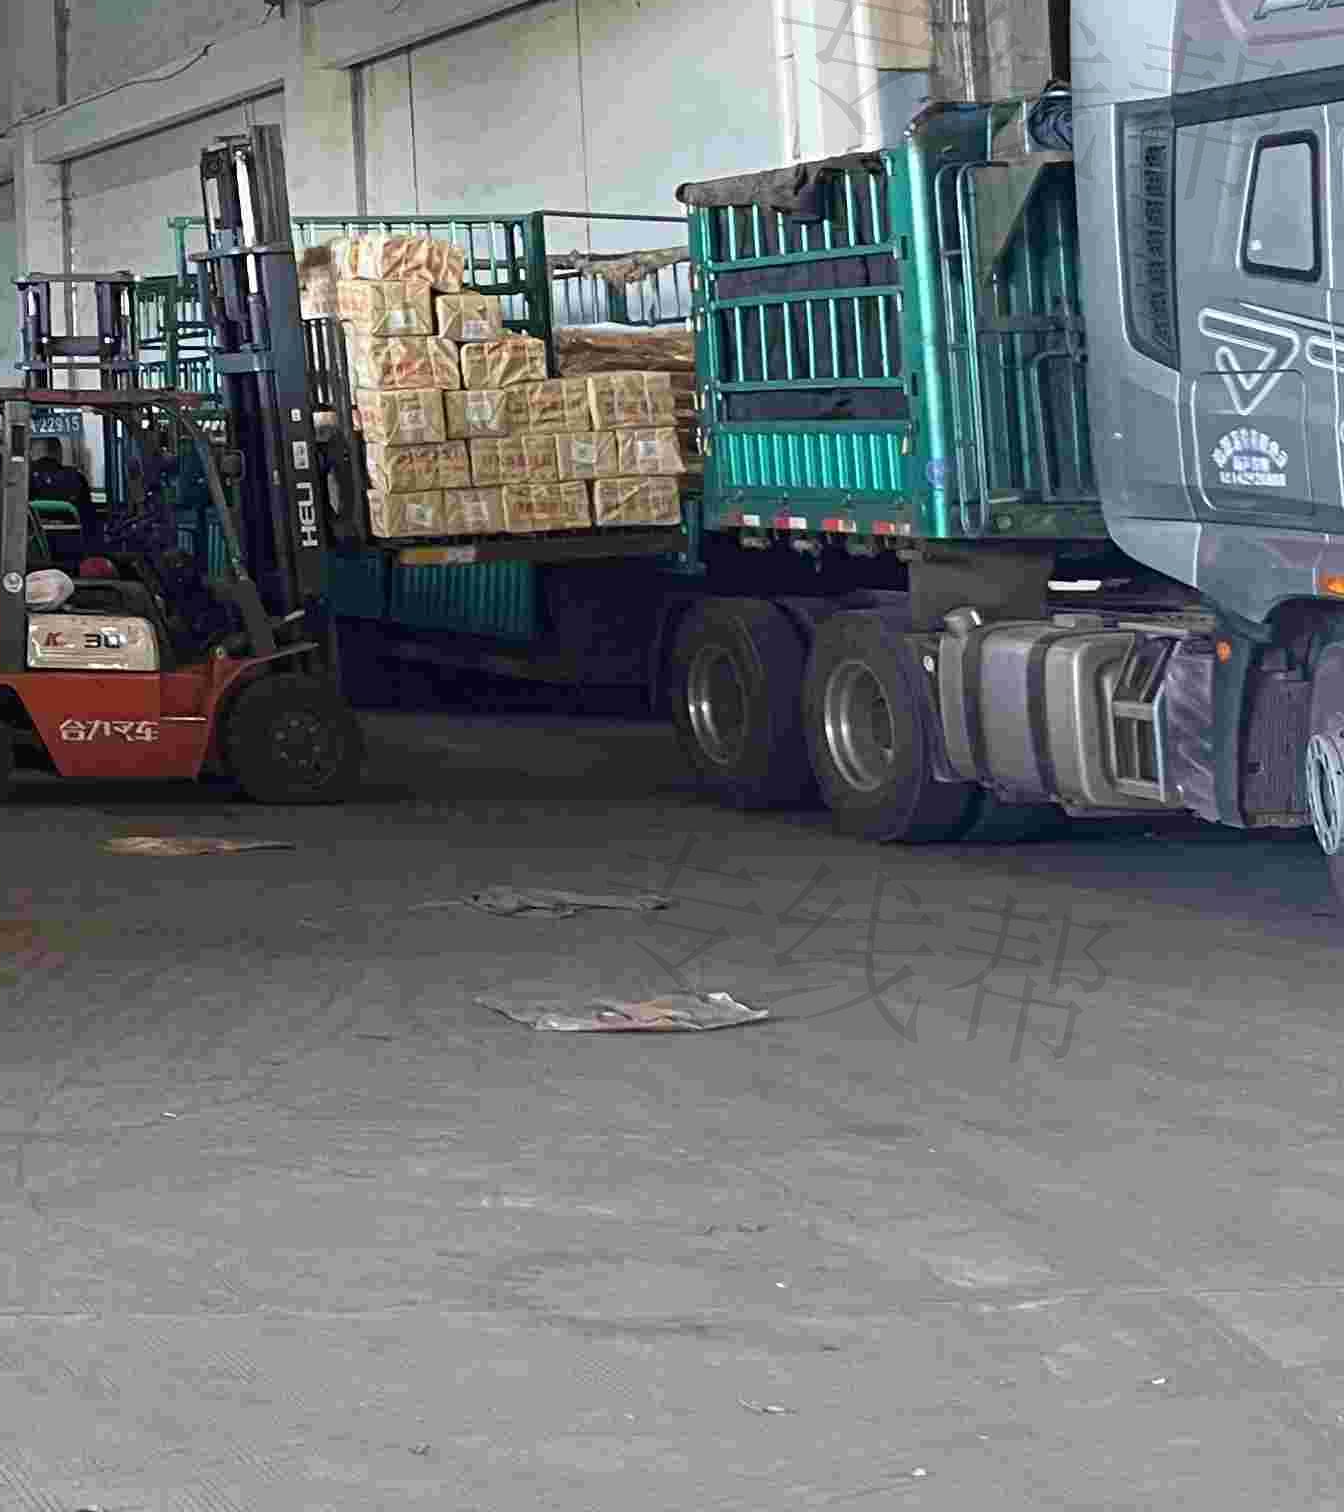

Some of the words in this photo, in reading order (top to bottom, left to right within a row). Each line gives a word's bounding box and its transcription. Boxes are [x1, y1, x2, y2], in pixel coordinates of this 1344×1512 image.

[296, 481, 318, 546] HELI
[59, 718, 160, 743] 合力叉车
